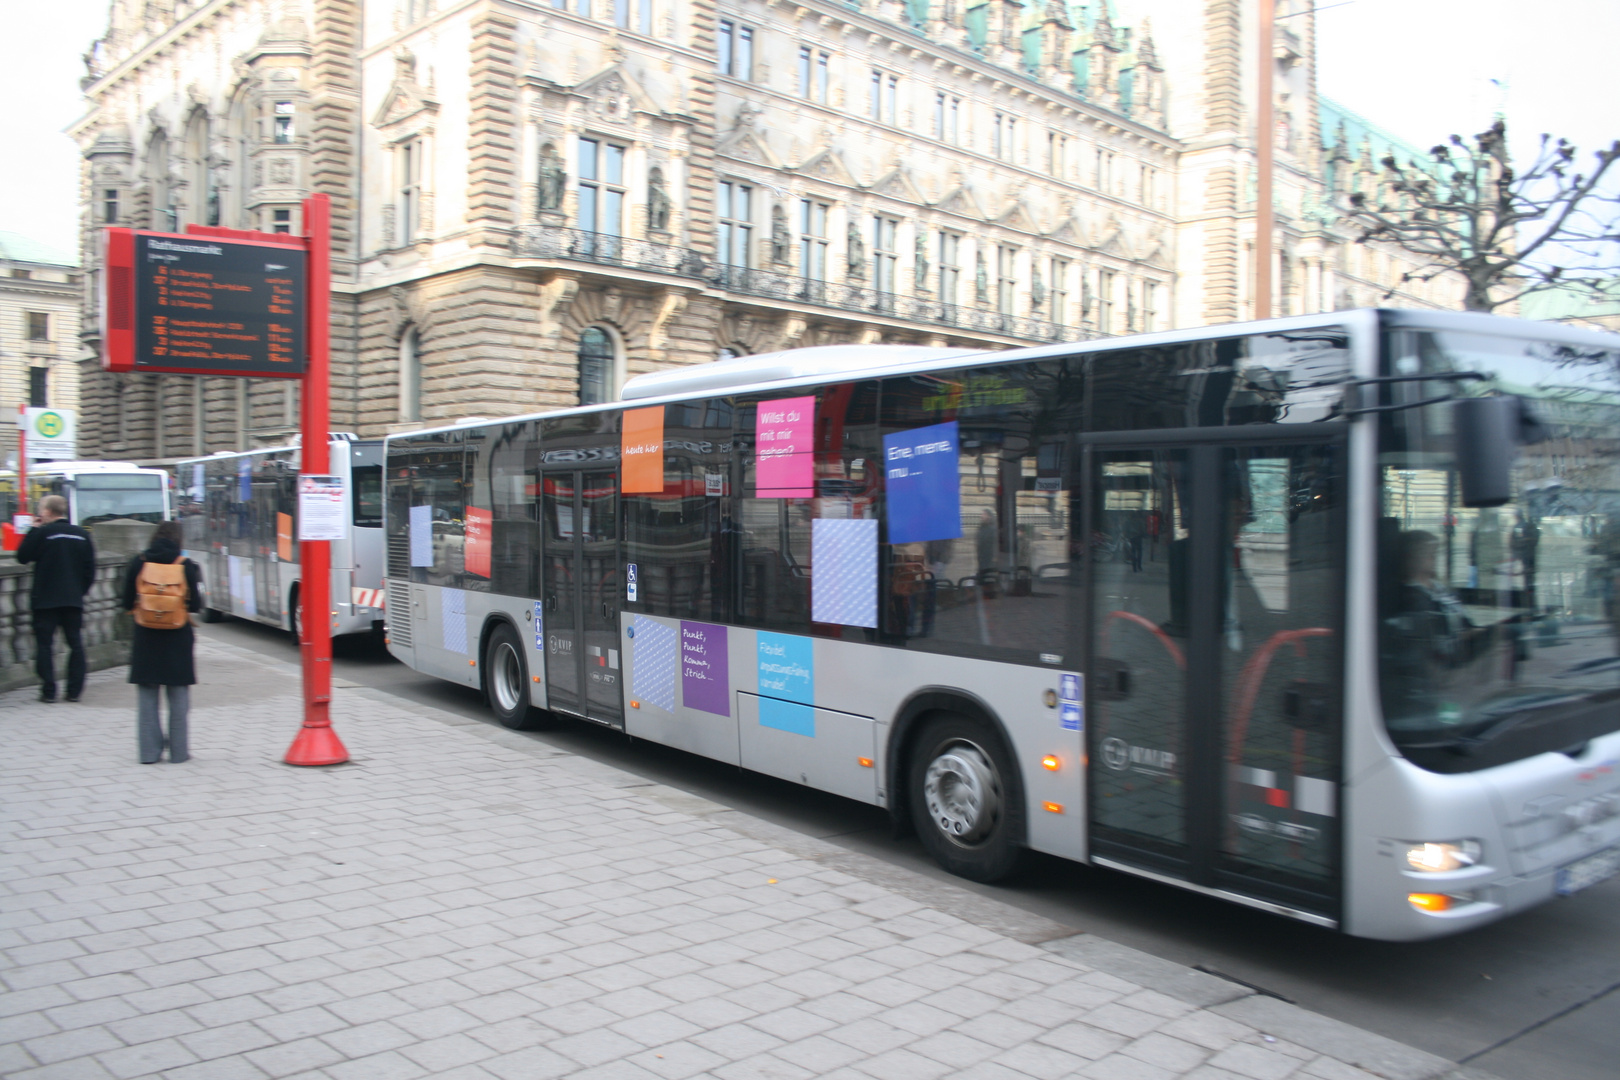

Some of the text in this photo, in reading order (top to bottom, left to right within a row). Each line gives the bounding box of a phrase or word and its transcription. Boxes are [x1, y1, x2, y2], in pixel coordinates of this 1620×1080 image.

[761, 410, 800, 424] Willst du
[760, 428, 793, 442] mit mir
[625, 445, 659, 454] heute hier
[760, 445, 795, 462] gehen?
[888, 446, 914, 461] Ene,
[683, 628, 706, 643] Punkt,
[558, 639, 572, 651] KVIP
[683, 641, 707, 656] Punkt,
[684, 655, 710, 669] Komma,
